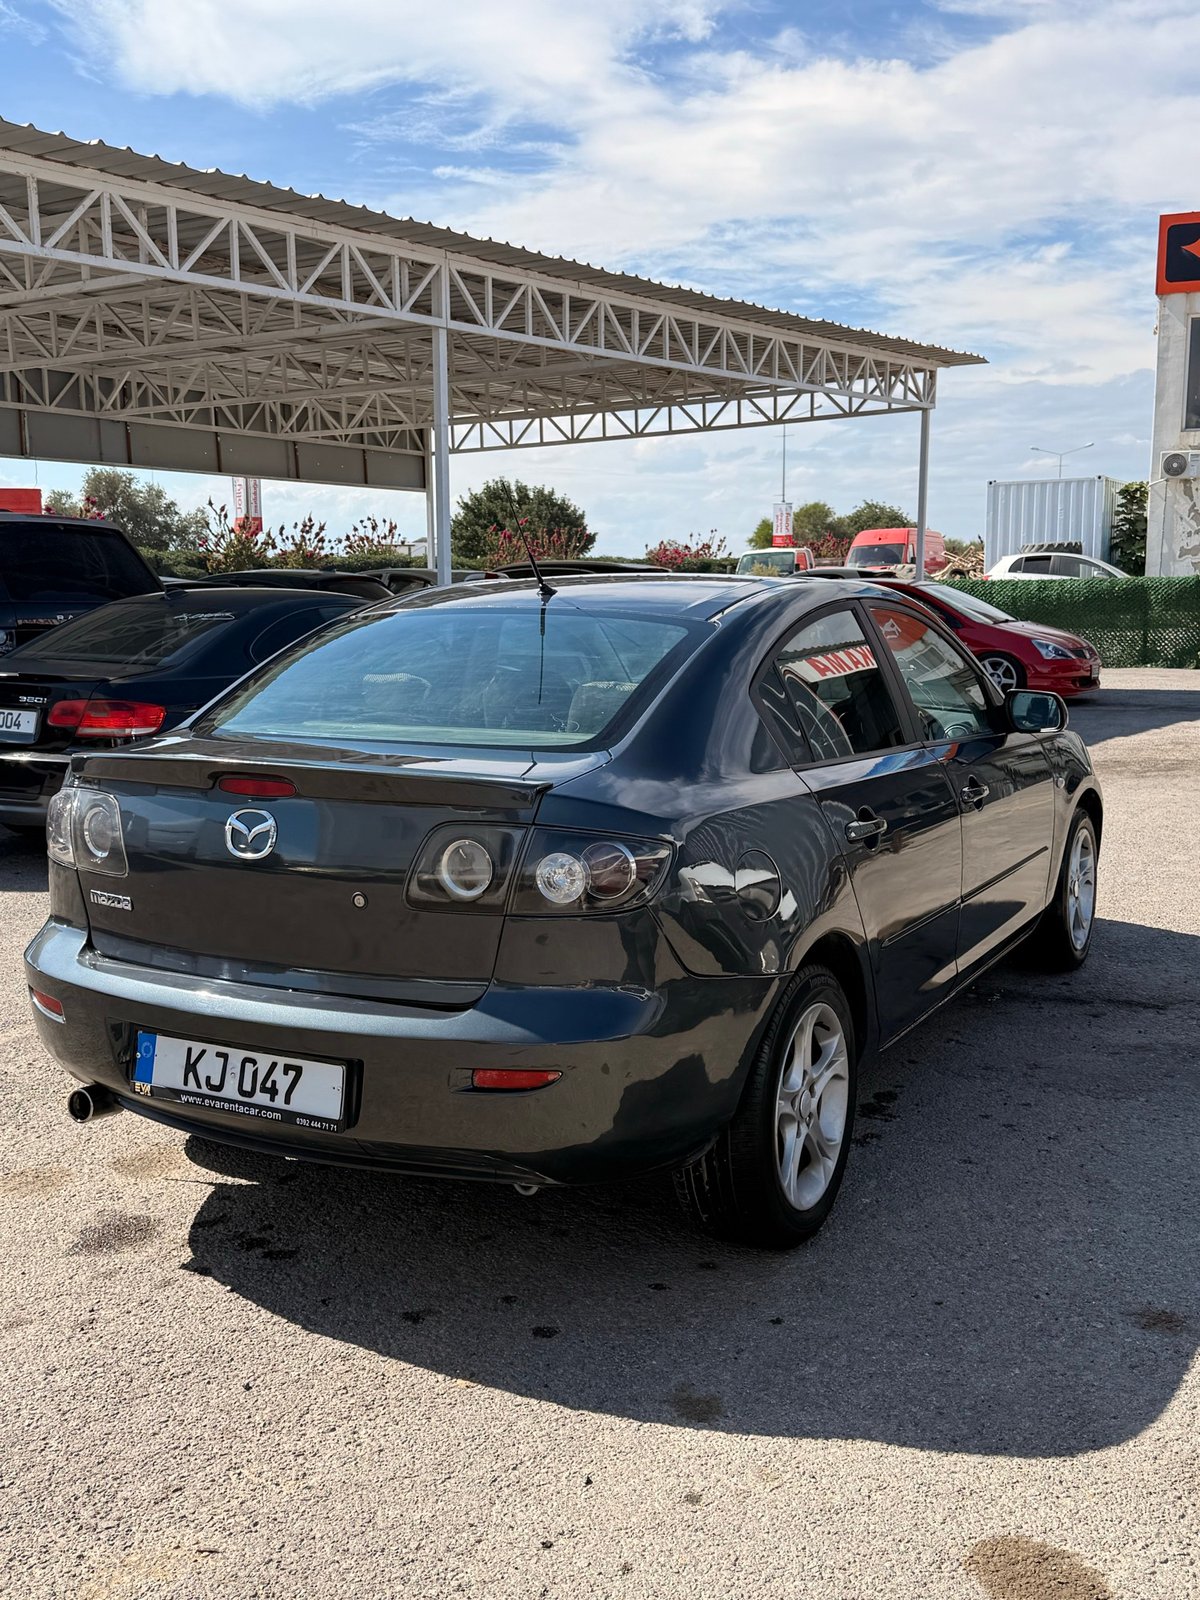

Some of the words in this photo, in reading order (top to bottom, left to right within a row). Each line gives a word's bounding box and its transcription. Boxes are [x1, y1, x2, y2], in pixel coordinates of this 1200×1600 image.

[235, 484, 243, 514] Jolly
[183, 1046, 229, 1093] KJ
[237, 1056, 303, 1105] 047
[180, 1093, 282, 1121] www.evarentacar.com
[296, 1117, 310, 1127] 0392
[310, 1120, 321, 1129] 444
[322, 1122, 329, 1130] 71
[330, 1124, 337, 1132] 71
